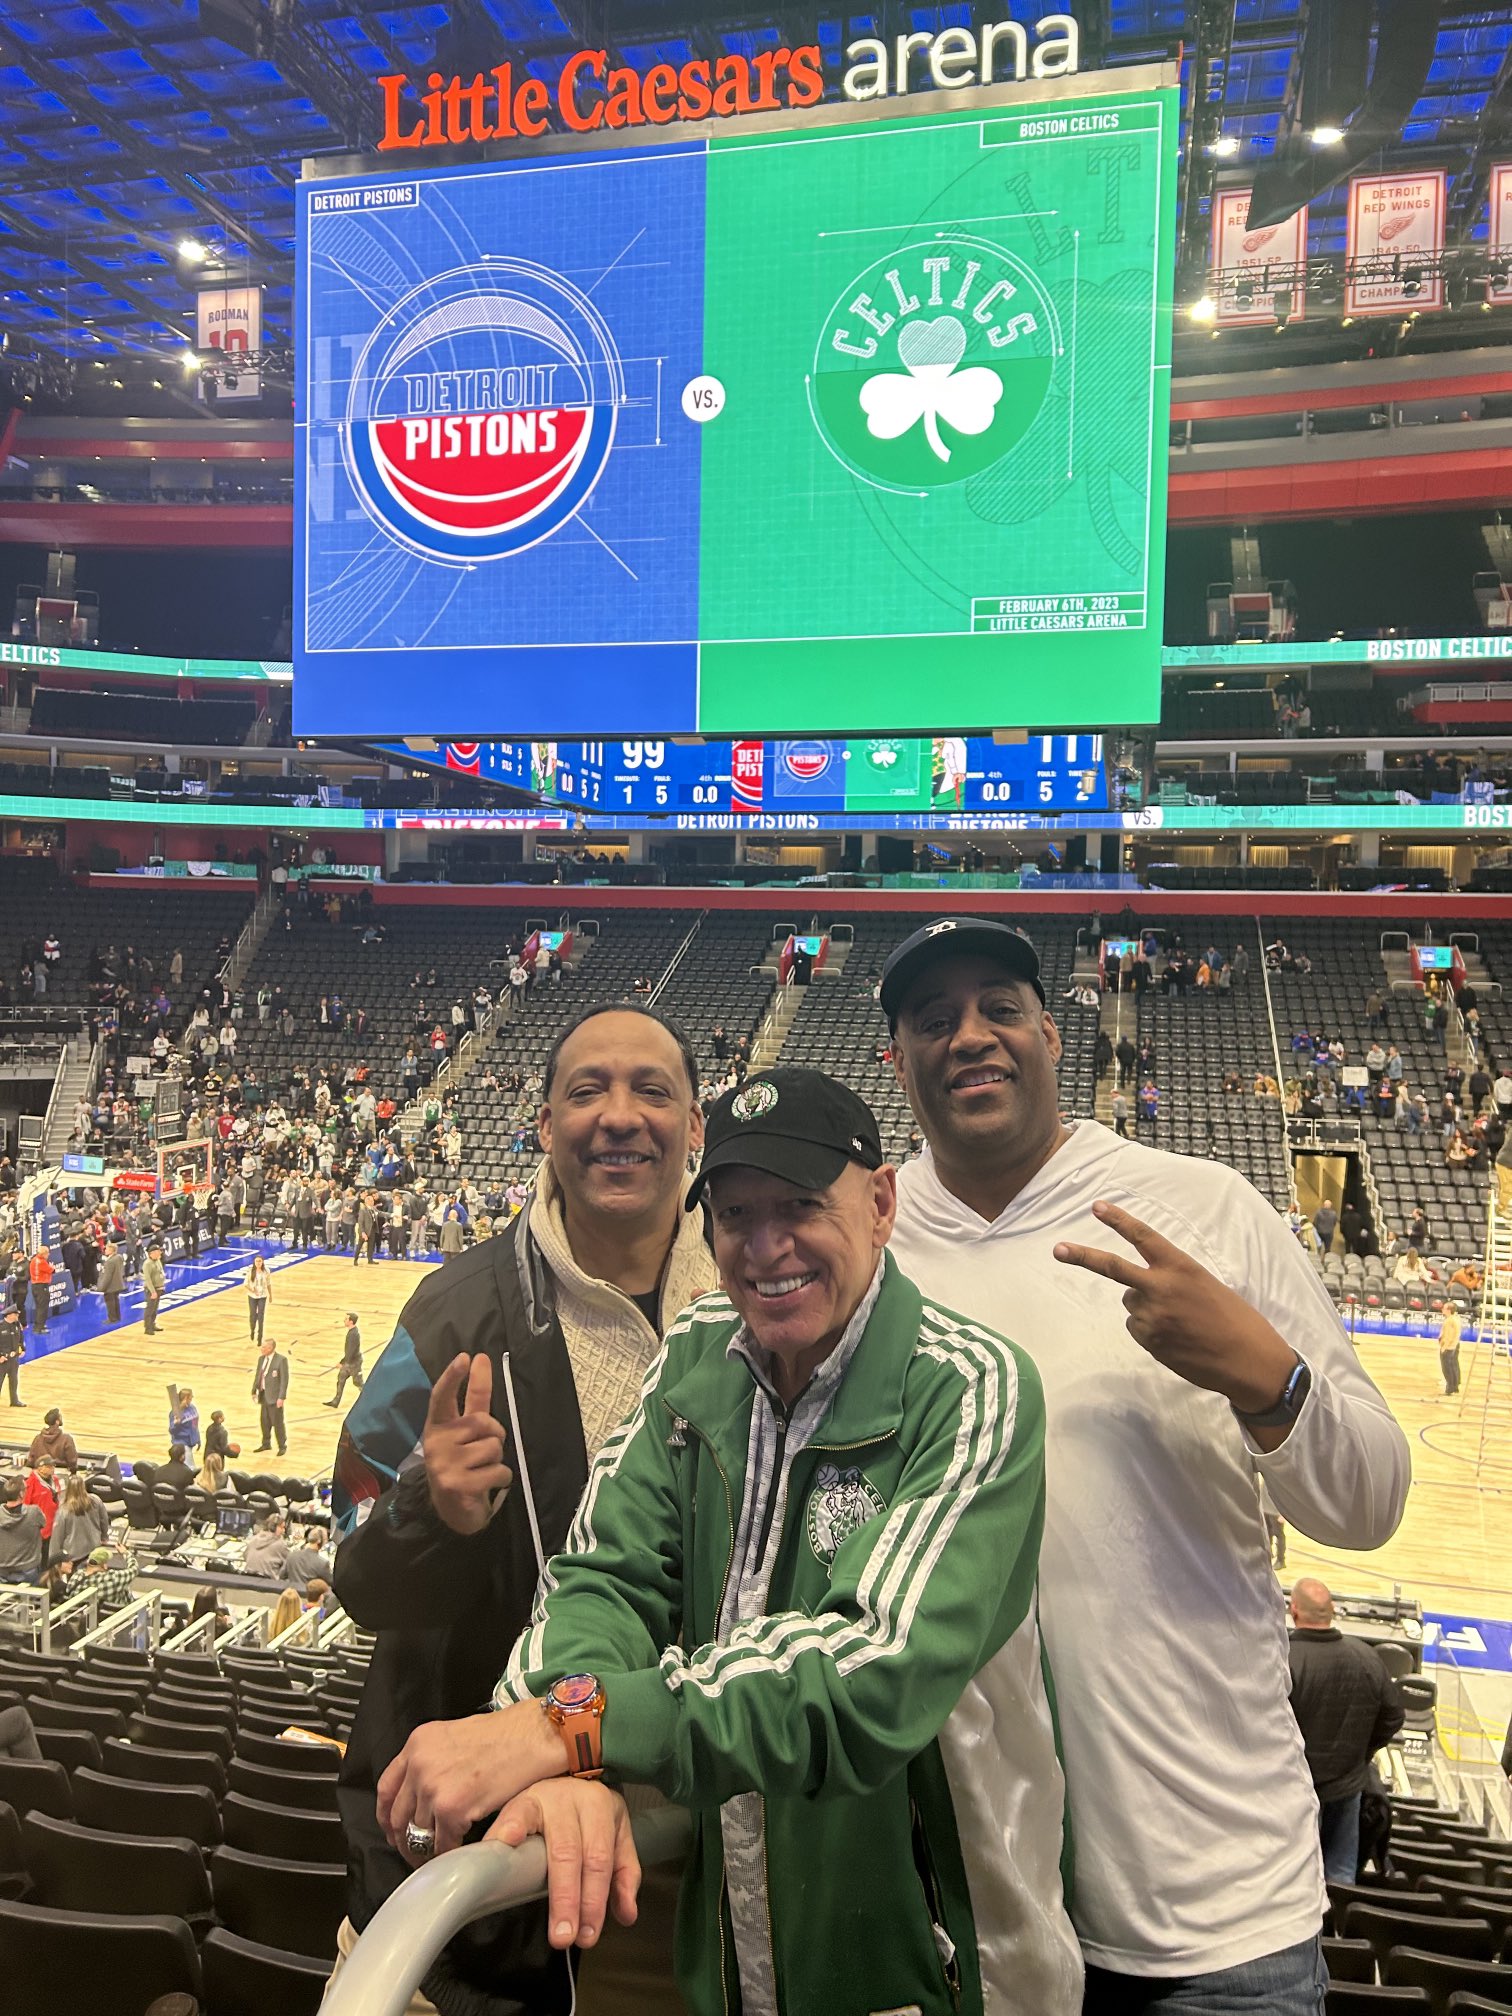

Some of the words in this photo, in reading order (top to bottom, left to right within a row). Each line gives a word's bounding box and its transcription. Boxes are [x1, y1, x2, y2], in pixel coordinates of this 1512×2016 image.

[377, 61, 549, 151] Little
[558, 49, 825, 132] Caesars
[844, 13, 1080, 100] arena
[1019, 118, 1068, 138] BOSTON
[1070, 112, 1120, 133] CELTICS
[314, 192, 361, 211] DETROIT
[364, 187, 412, 207] PISTONS
[1373, 186, 1422, 199] DETROIT
[1364, 203, 1386, 213] RED
[1391, 199, 1430, 211] WINGS
[1360, 284, 1428, 298] CHAMPS
[208, 308, 248, 324] RODMAN
[831, 256, 1038, 359] CELTICS
[403, 364, 558, 415] DETROIT
[692, 389, 719, 409] VS.
[402, 410, 558, 461] PISTONS
[999, 598, 1058, 614] FEBRUARY
[1061, 598, 1088, 613] 6TH,
[1091, 596, 1119, 610] 2023
[990, 617, 1027, 631] LITTLE
[1030, 615, 1084, 630] CAESARS
[1087, 613, 1128, 627] ARENA
[0, 643, 61, 666] ELTICS
[1367, 639, 1441, 660] BOSTON
[581, 778, 588, 799] 5
[593, 782, 600, 802] 2
[622, 785, 633, 804] 1
[656, 785, 668, 805] 5
[692, 785, 719, 804] 0.0
[982, 783, 1011, 801] 0.0
[1039, 781, 1054, 802] 5
[809, 1489, 824, 1555] BOSTON
